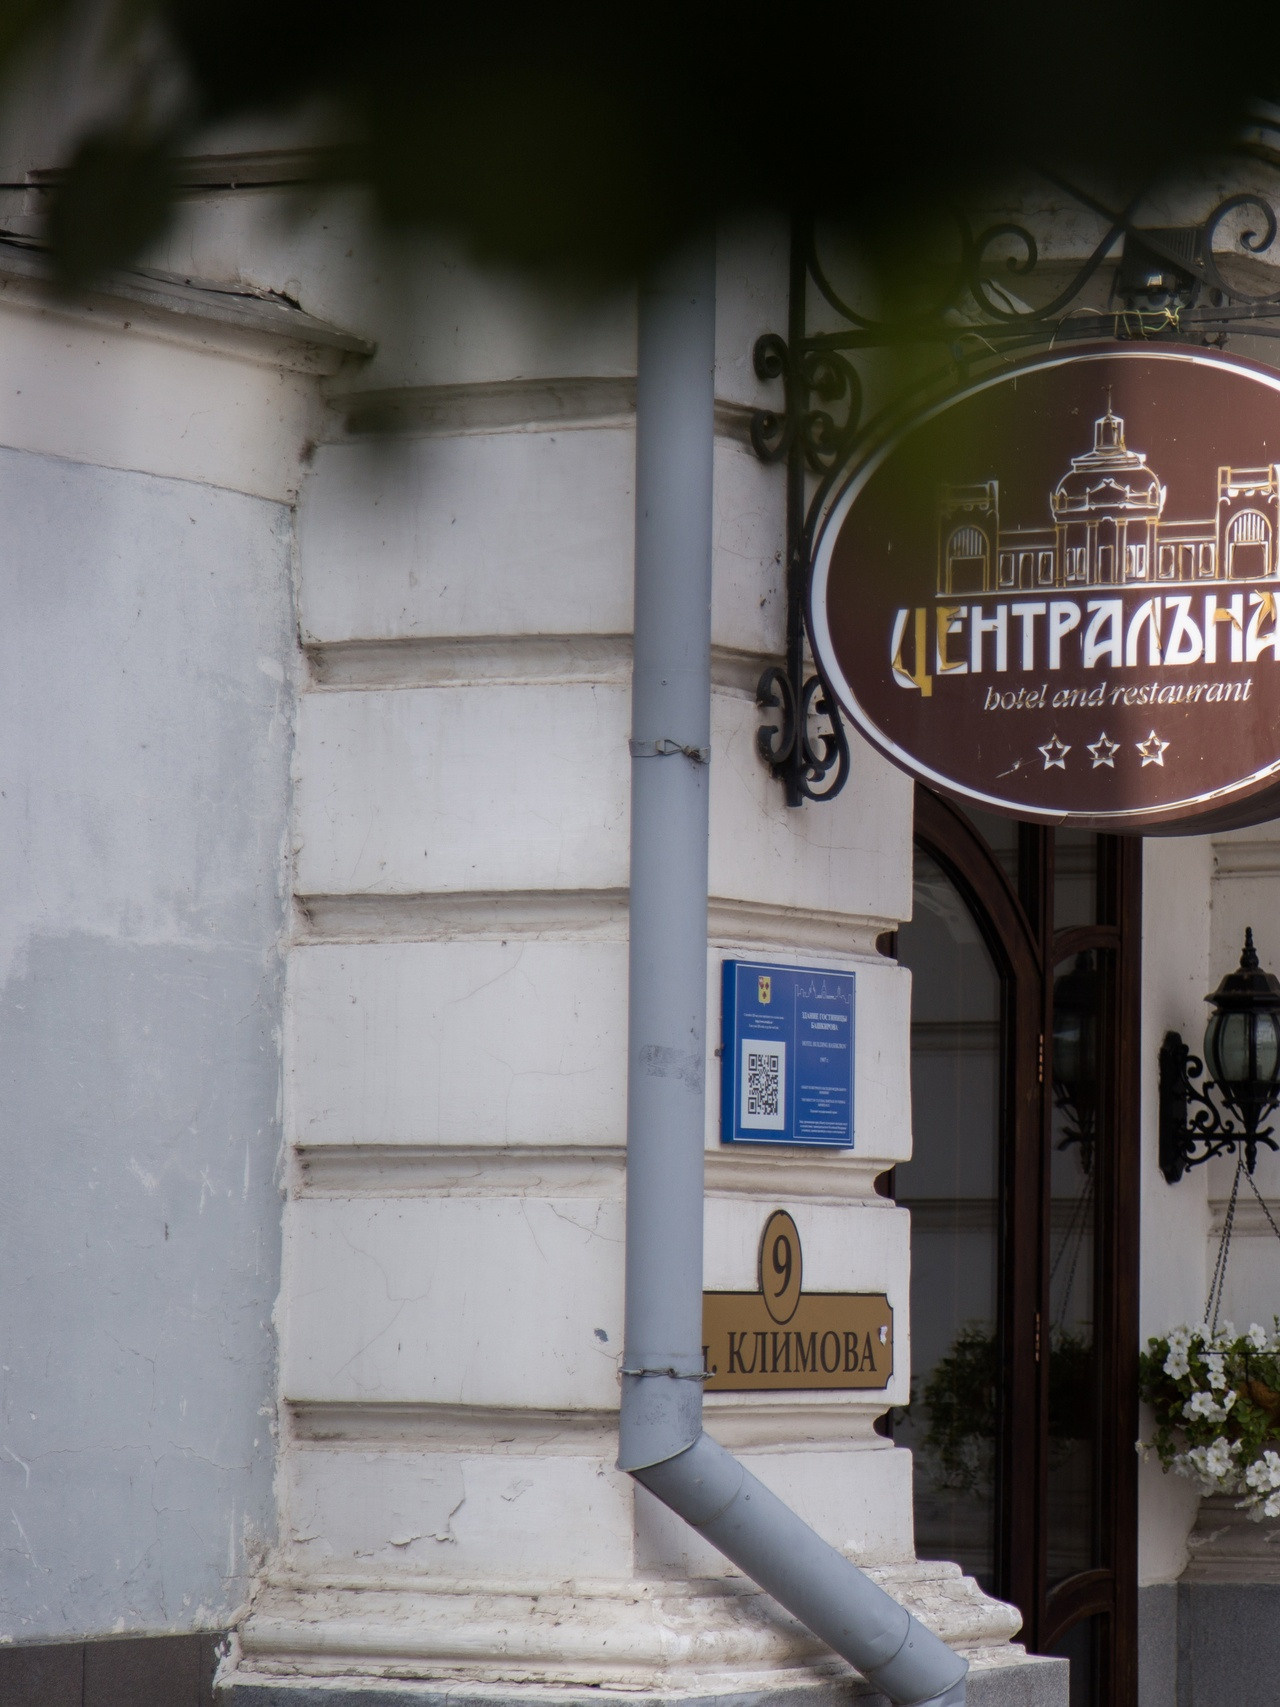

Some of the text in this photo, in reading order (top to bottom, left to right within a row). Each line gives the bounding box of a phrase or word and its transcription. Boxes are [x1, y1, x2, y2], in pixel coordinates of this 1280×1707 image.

[983, 678, 1253, 711] hotel and restaurant
[772, 1234, 792, 1298] 9
[726, 1330, 877, 1374] КЛИМОВА
